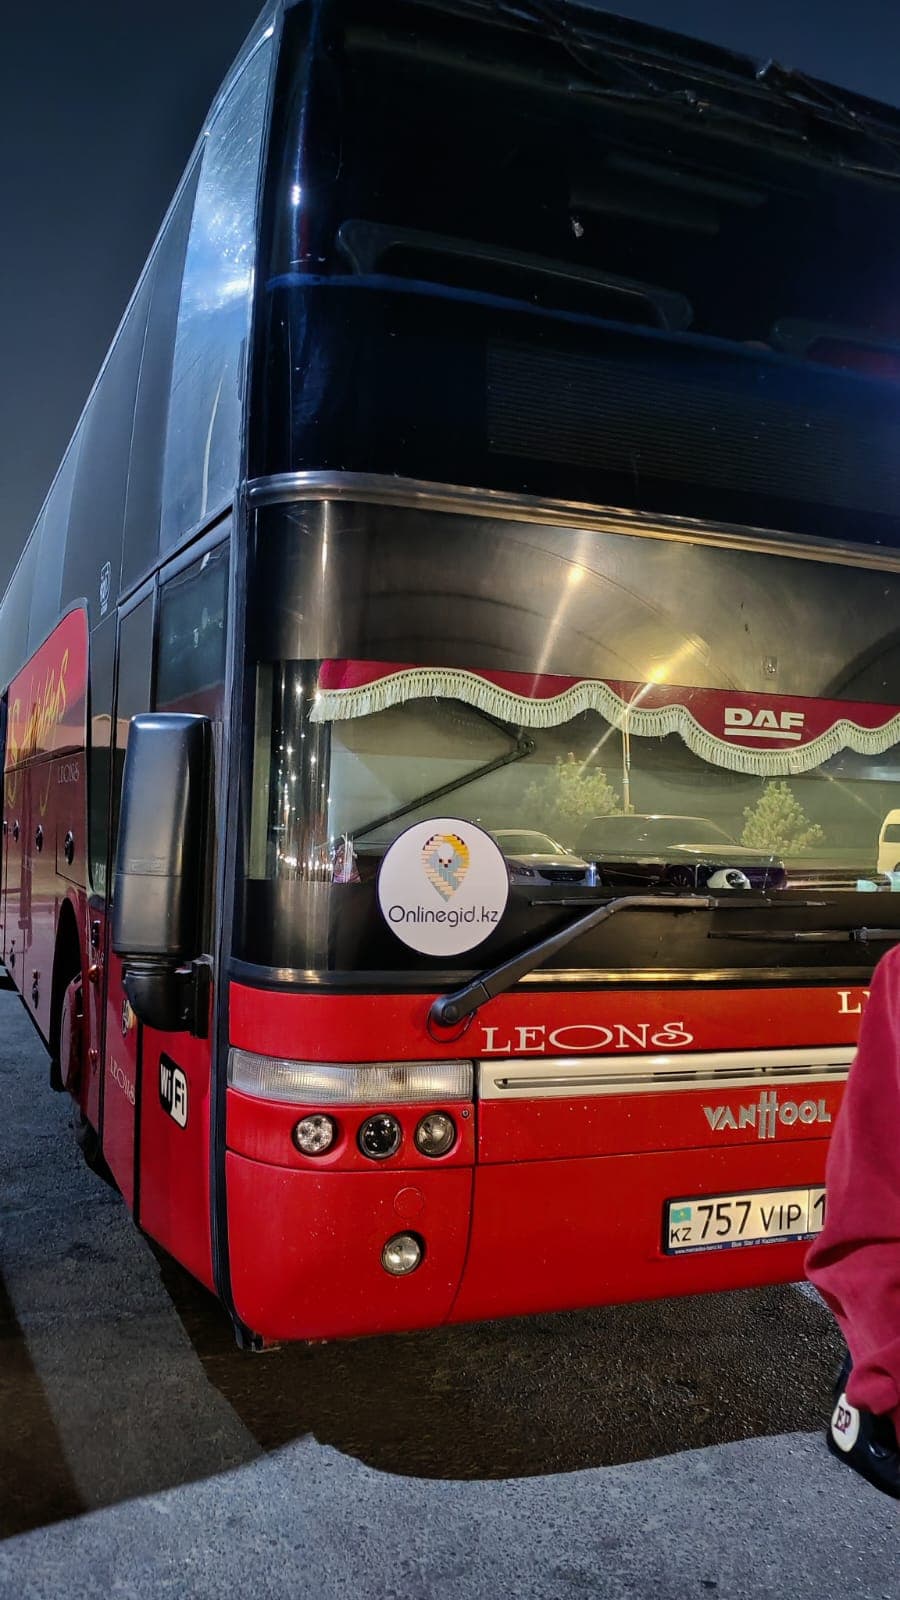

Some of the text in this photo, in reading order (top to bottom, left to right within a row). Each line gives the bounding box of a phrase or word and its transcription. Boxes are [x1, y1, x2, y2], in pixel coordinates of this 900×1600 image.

[724, 708, 805, 730] DAF
[388, 905, 499, 928] Onlinegid.kz
[837, 991, 871, 1014] L
[480, 1021, 695, 1053] LEONS
[160, 1063, 185, 1117] WiFi
[697, 1201, 752, 1239] 757
[760, 1204, 802, 1231] VIP
[671, 1227, 692, 1243] KZ
